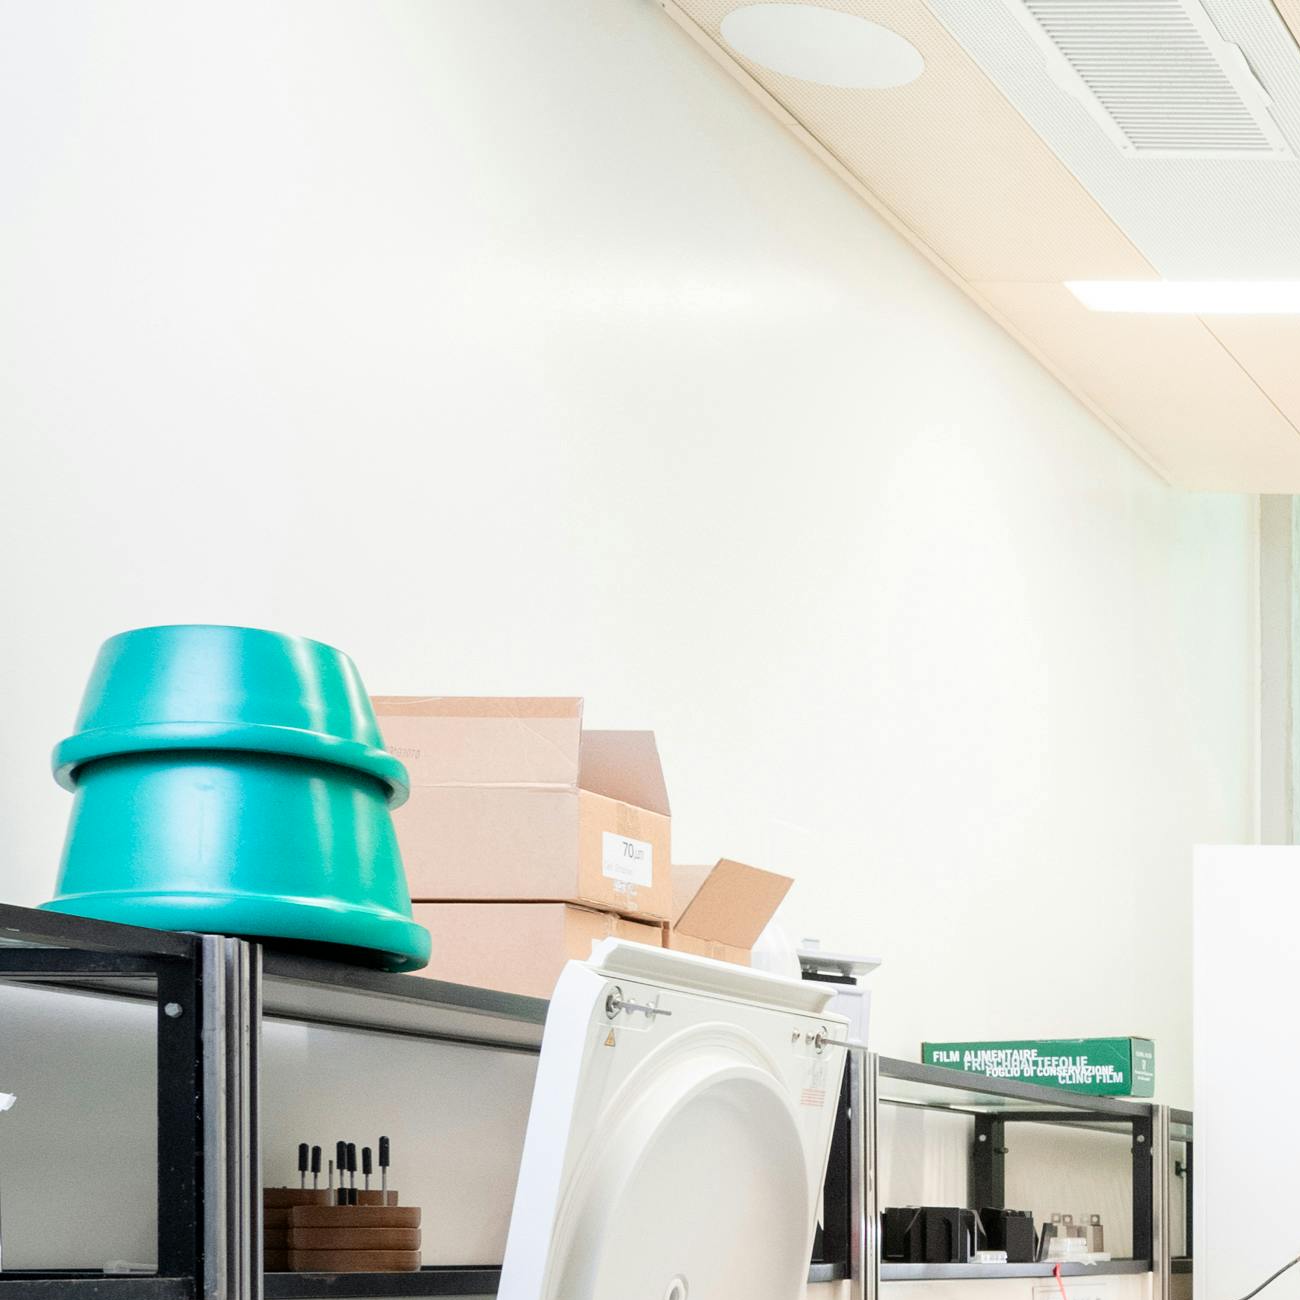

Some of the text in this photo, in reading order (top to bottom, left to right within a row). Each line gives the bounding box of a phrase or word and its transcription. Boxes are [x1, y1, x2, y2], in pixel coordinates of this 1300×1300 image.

[932, 1049, 1038, 1062] FILM ALIMENTAIRE
[985, 1067, 1021, 1078] FOGLIO
[1023, 1066, 1034, 1077] DI
[1058, 1071, 1123, 1084] CLING FILM
